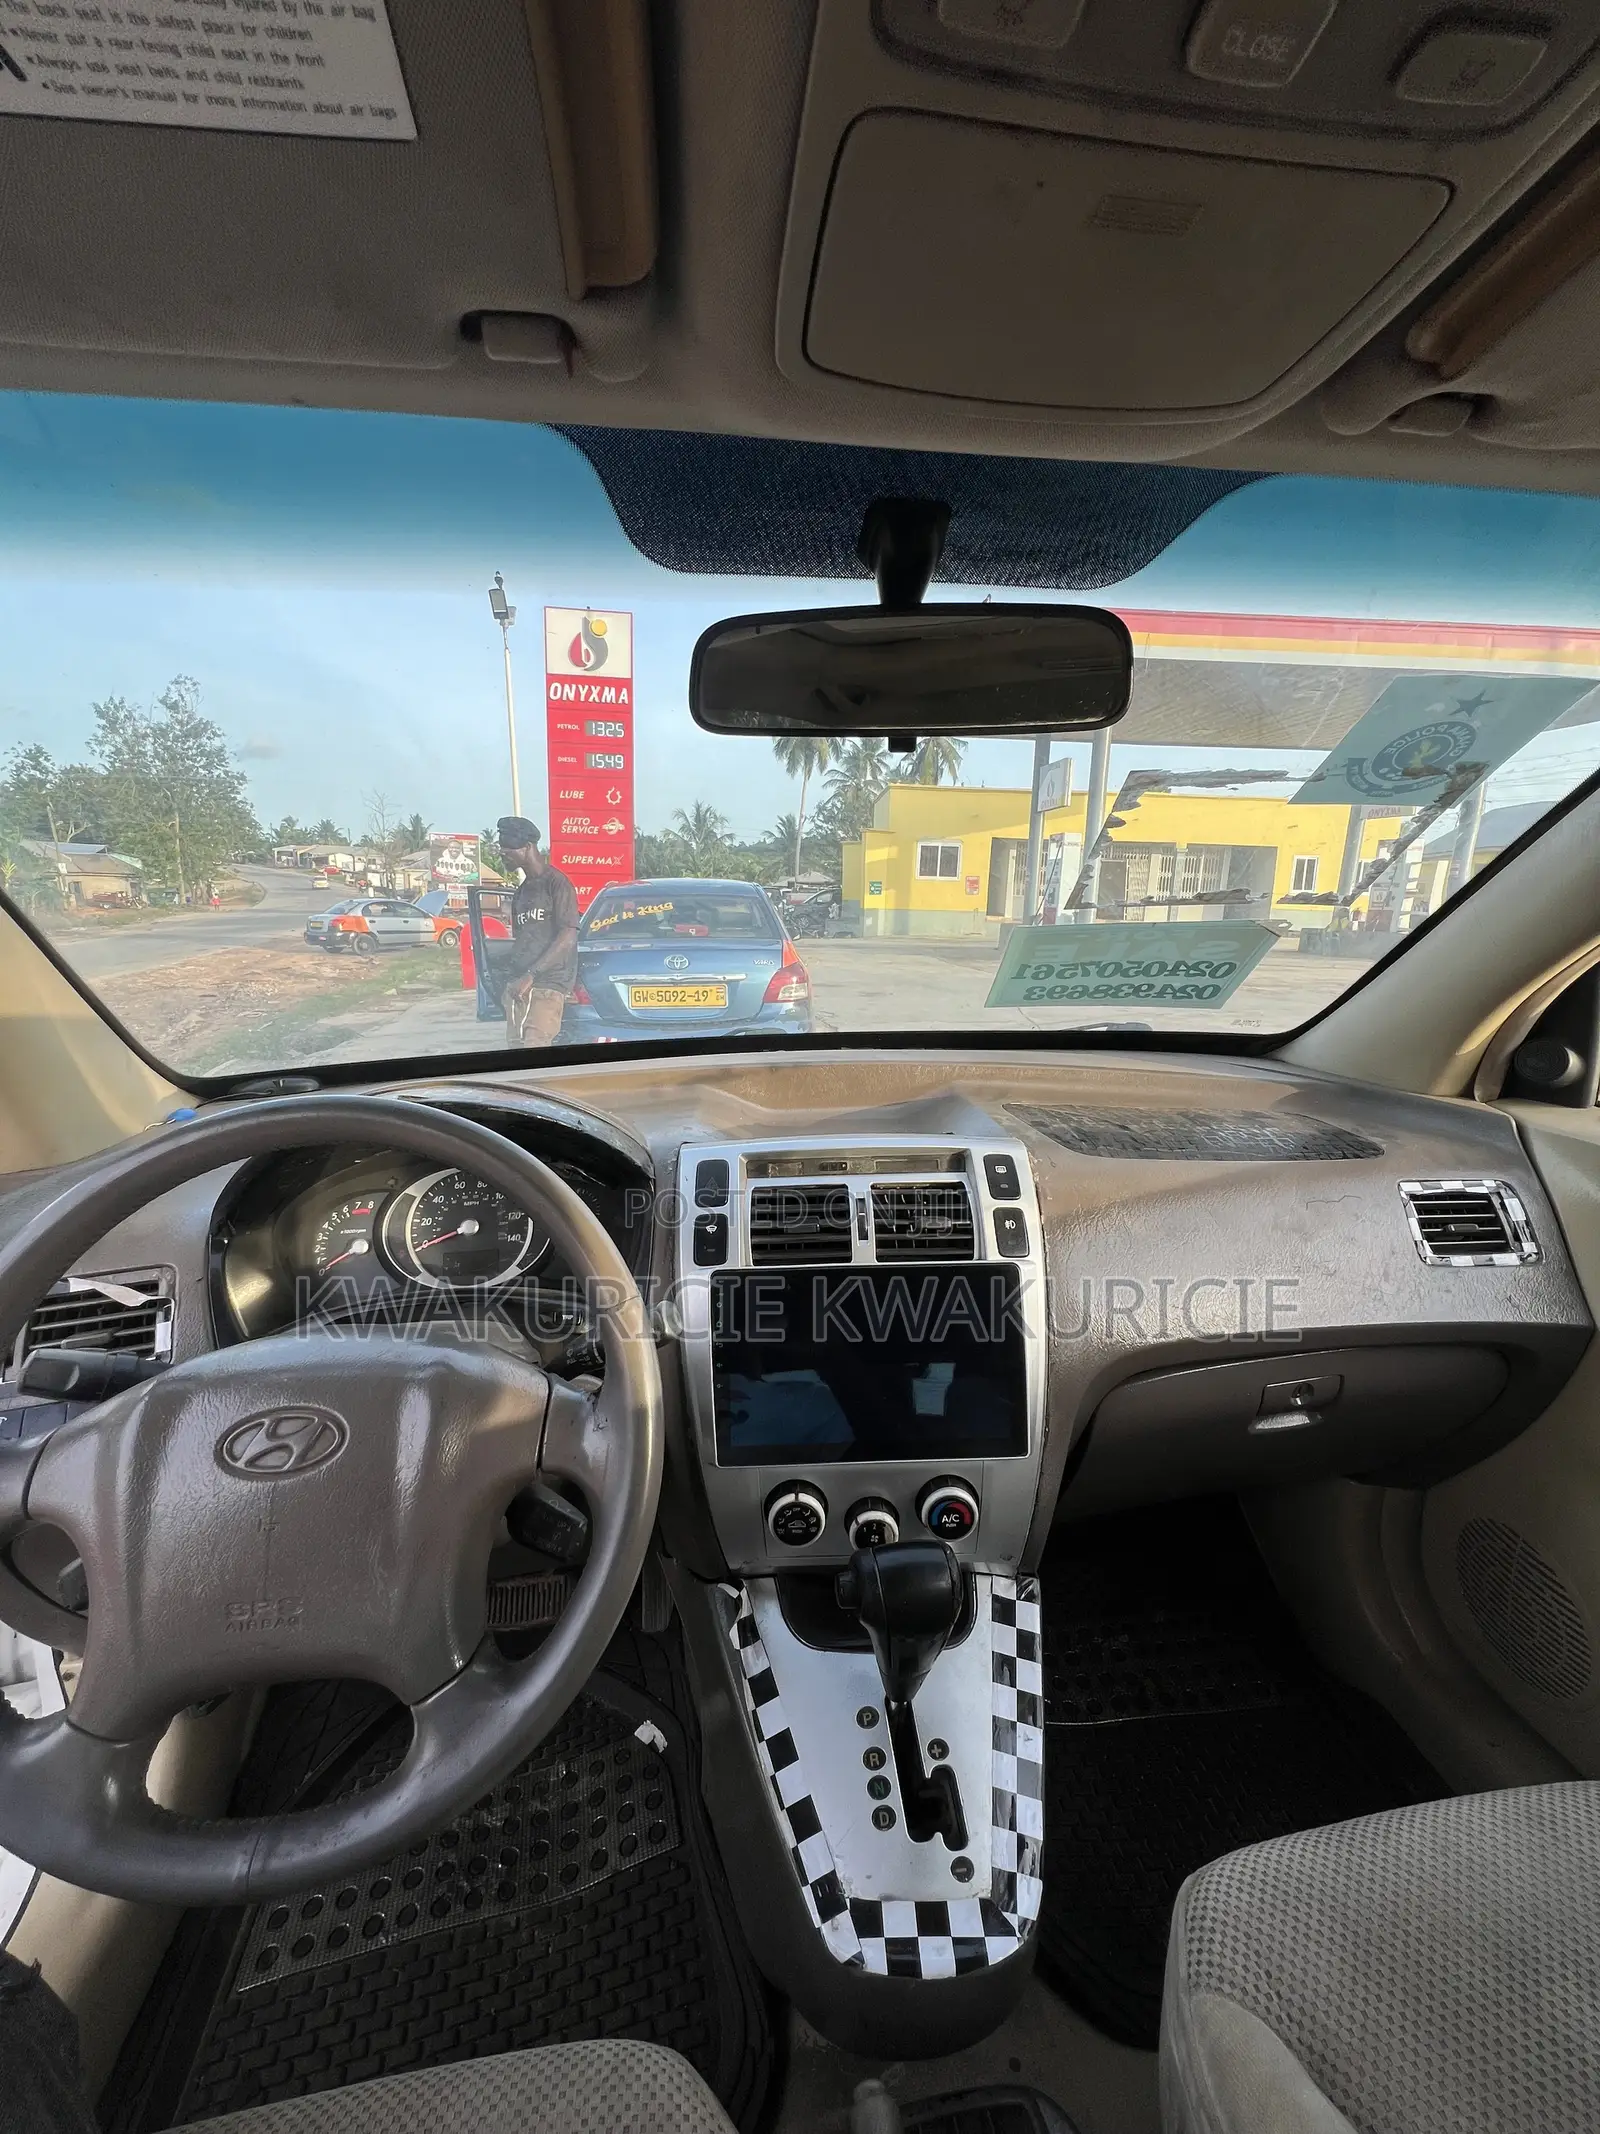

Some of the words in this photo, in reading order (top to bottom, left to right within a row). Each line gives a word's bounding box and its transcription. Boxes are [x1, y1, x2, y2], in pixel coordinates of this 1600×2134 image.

[263, 25, 314, 41] children
[549, 682, 629, 704] ONYXMA
[559, 790, 585, 799] LUBE
[562, 817, 591, 825] AUTO
[561, 825, 599, 834] SERVICE
[561, 854, 594, 864] SUPER
[595, 855, 625, 866] MAX
[590, 914, 619, 932] God
[454, 1181, 466, 1190] 60
[432, 1195, 445, 1203] 40
[342, 1204, 349, 1213] 6
[355, 1201, 362, 1209] 7
[368, 1200, 375, 1209] 8
[331, 1212, 338, 1220] 5
[508, 1211, 521, 1220] 120
[322, 1221, 329, 1229] 4
[421, 1217, 433, 1226] 20
[317, 1232, 323, 1241] 3
[507, 1233, 521, 1242] 140
[314, 1244, 321, 1253] 2
[941, 1513, 960, 1523] A/C
[863, 1712, 872, 1726] P
[869, 1752, 880, 1767] R
[873, 1781, 885, 1796] N
[879, 1811, 890, 1827] D
